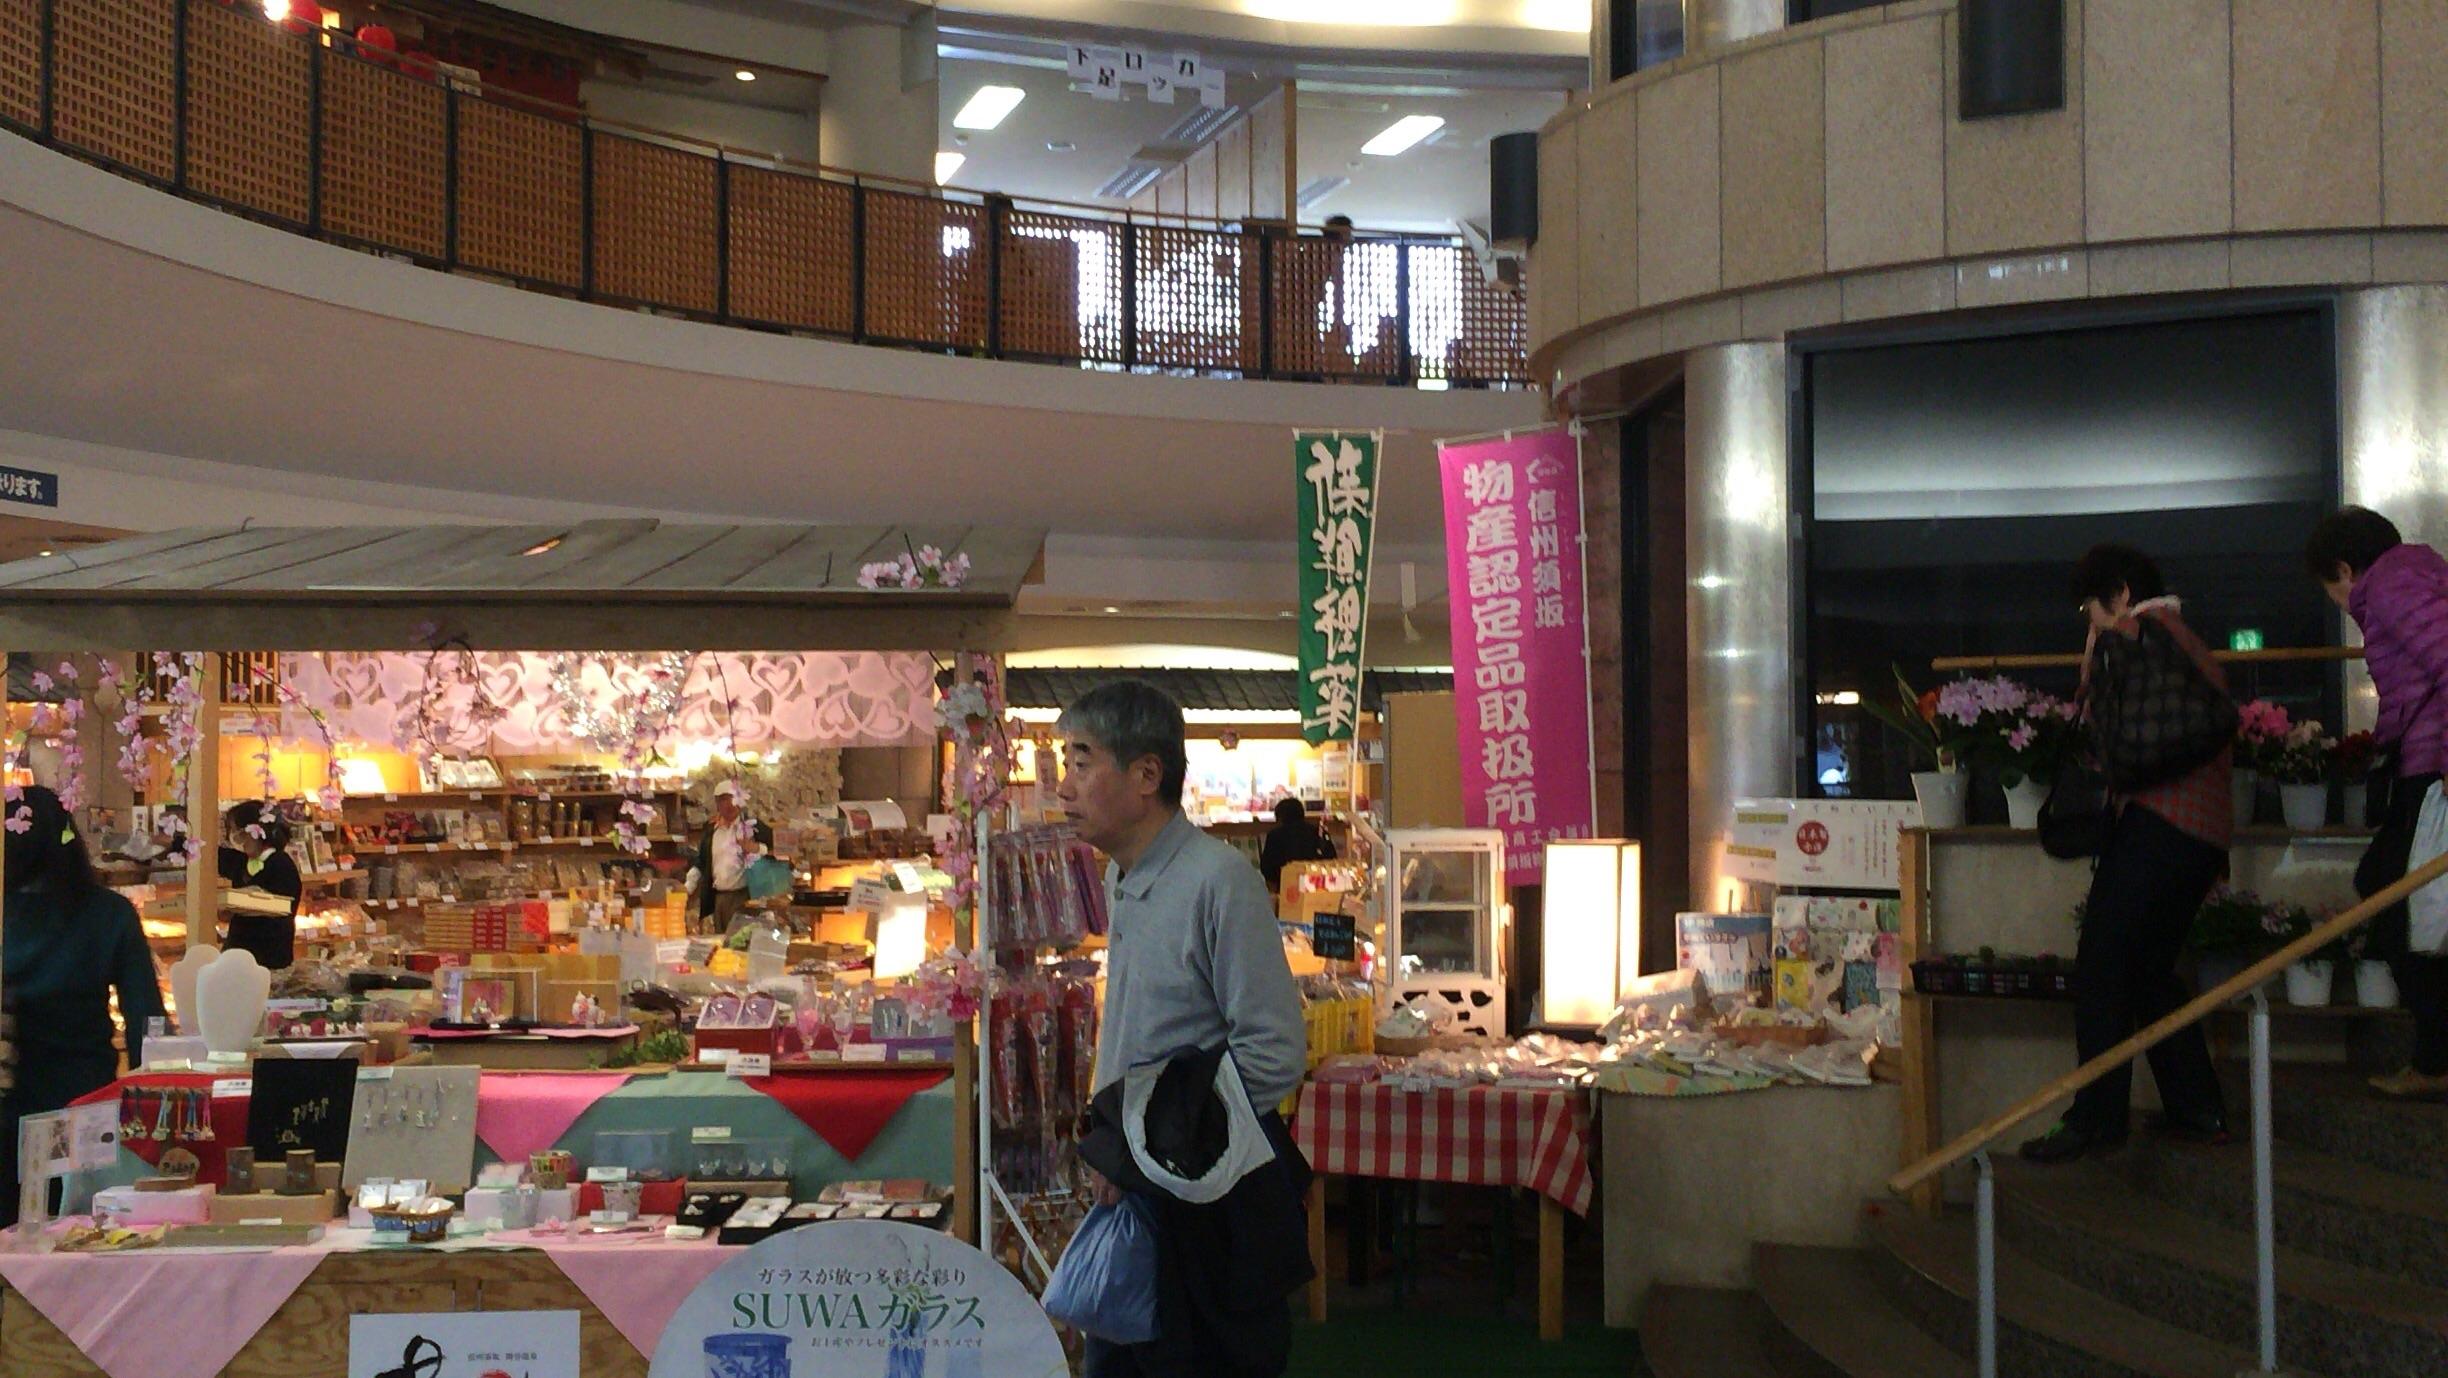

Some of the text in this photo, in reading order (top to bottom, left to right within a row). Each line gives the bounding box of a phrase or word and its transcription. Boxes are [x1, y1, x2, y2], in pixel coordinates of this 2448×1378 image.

[1527, 489, 1565, 629] 信州須坂
[1463, 459, 1537, 827] 物産認定品取扱所
[732, 1292, 986, 1331] SUWAガラス
[758, 1268, 967, 1288] ガラスが放つ多彩な彩り
